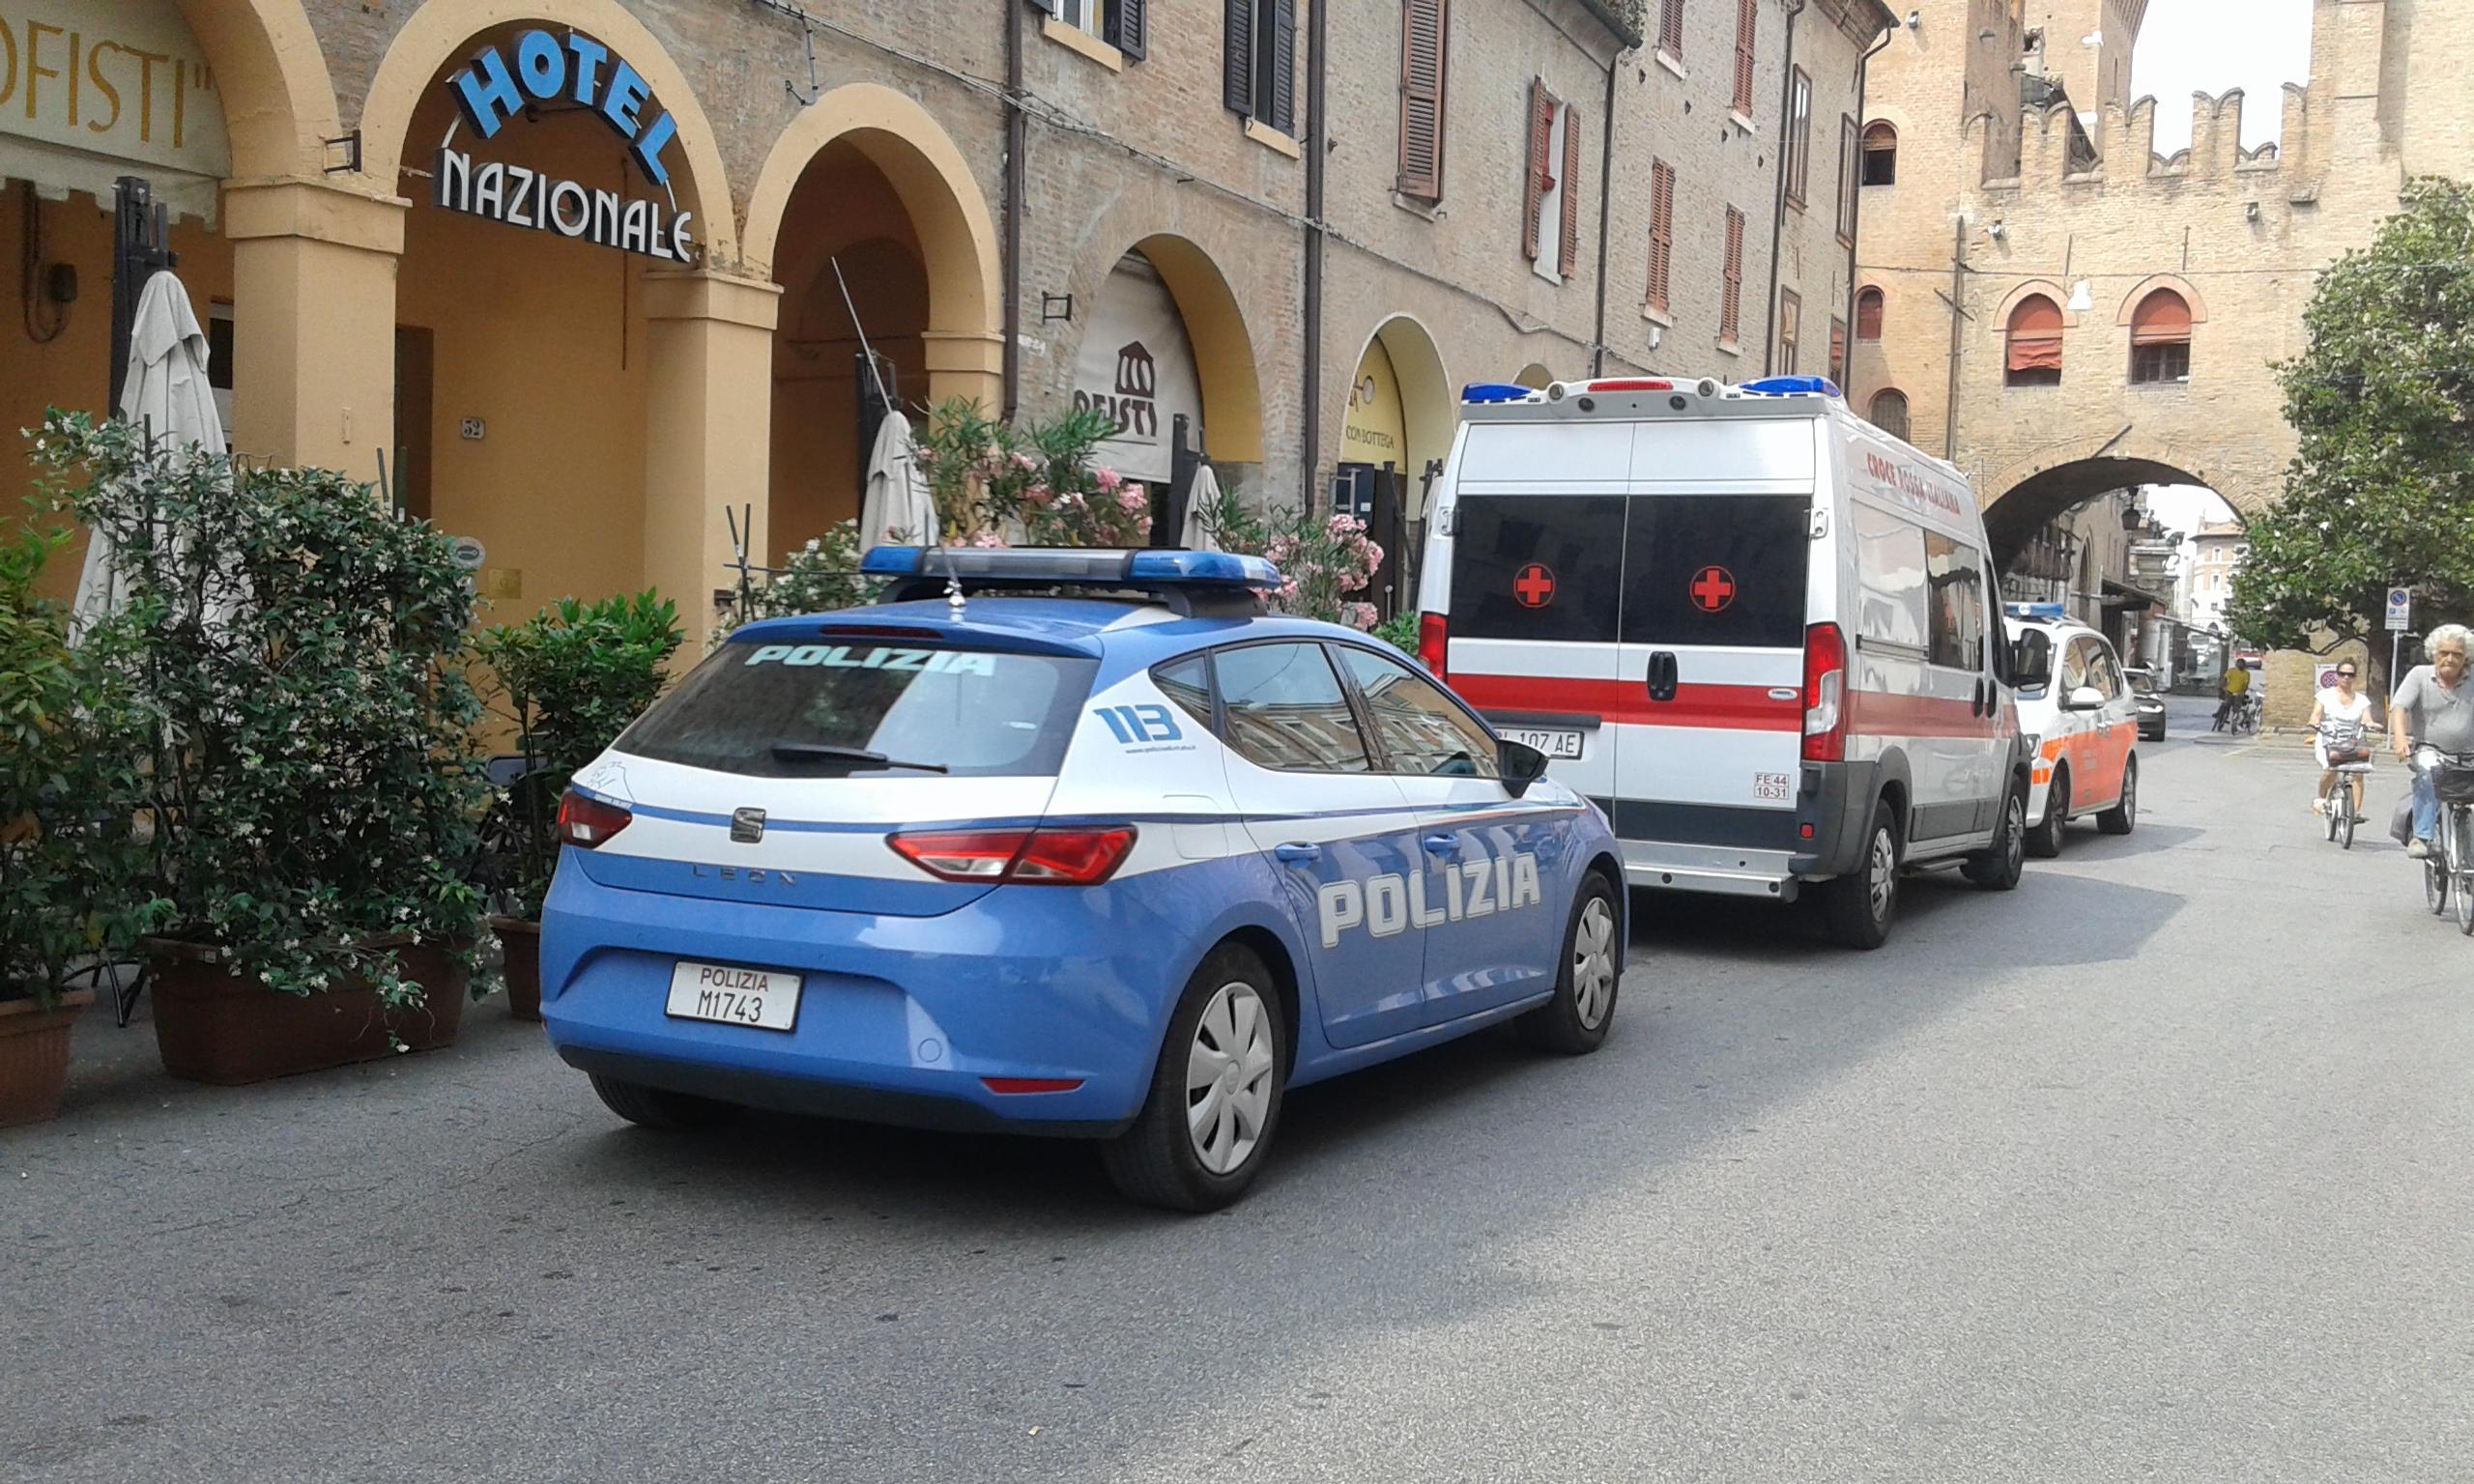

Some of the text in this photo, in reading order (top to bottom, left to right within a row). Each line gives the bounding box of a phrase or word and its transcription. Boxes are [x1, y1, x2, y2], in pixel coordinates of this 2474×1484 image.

[450, 27, 678, 186] HOTEL
[439, 147, 692, 264] NAZIONALE
[1362, 429, 1395, 449] BOTTEGA
[1867, 452, 1897, 487] CROCE
[744, 644, 997, 677] POLIZIA
[1092, 704, 1183, 744] 113
[1554, 734, 1576, 753] AE
[1756, 774, 1787, 785] FE 44
[1757, 787, 1786, 798] 10-31
[693, 865, 798, 885] LEON
[1318, 851, 1541, 949] POLIZIA
[700, 967, 769, 992] POLIZIA
[696, 989, 763, 1023] M1743
